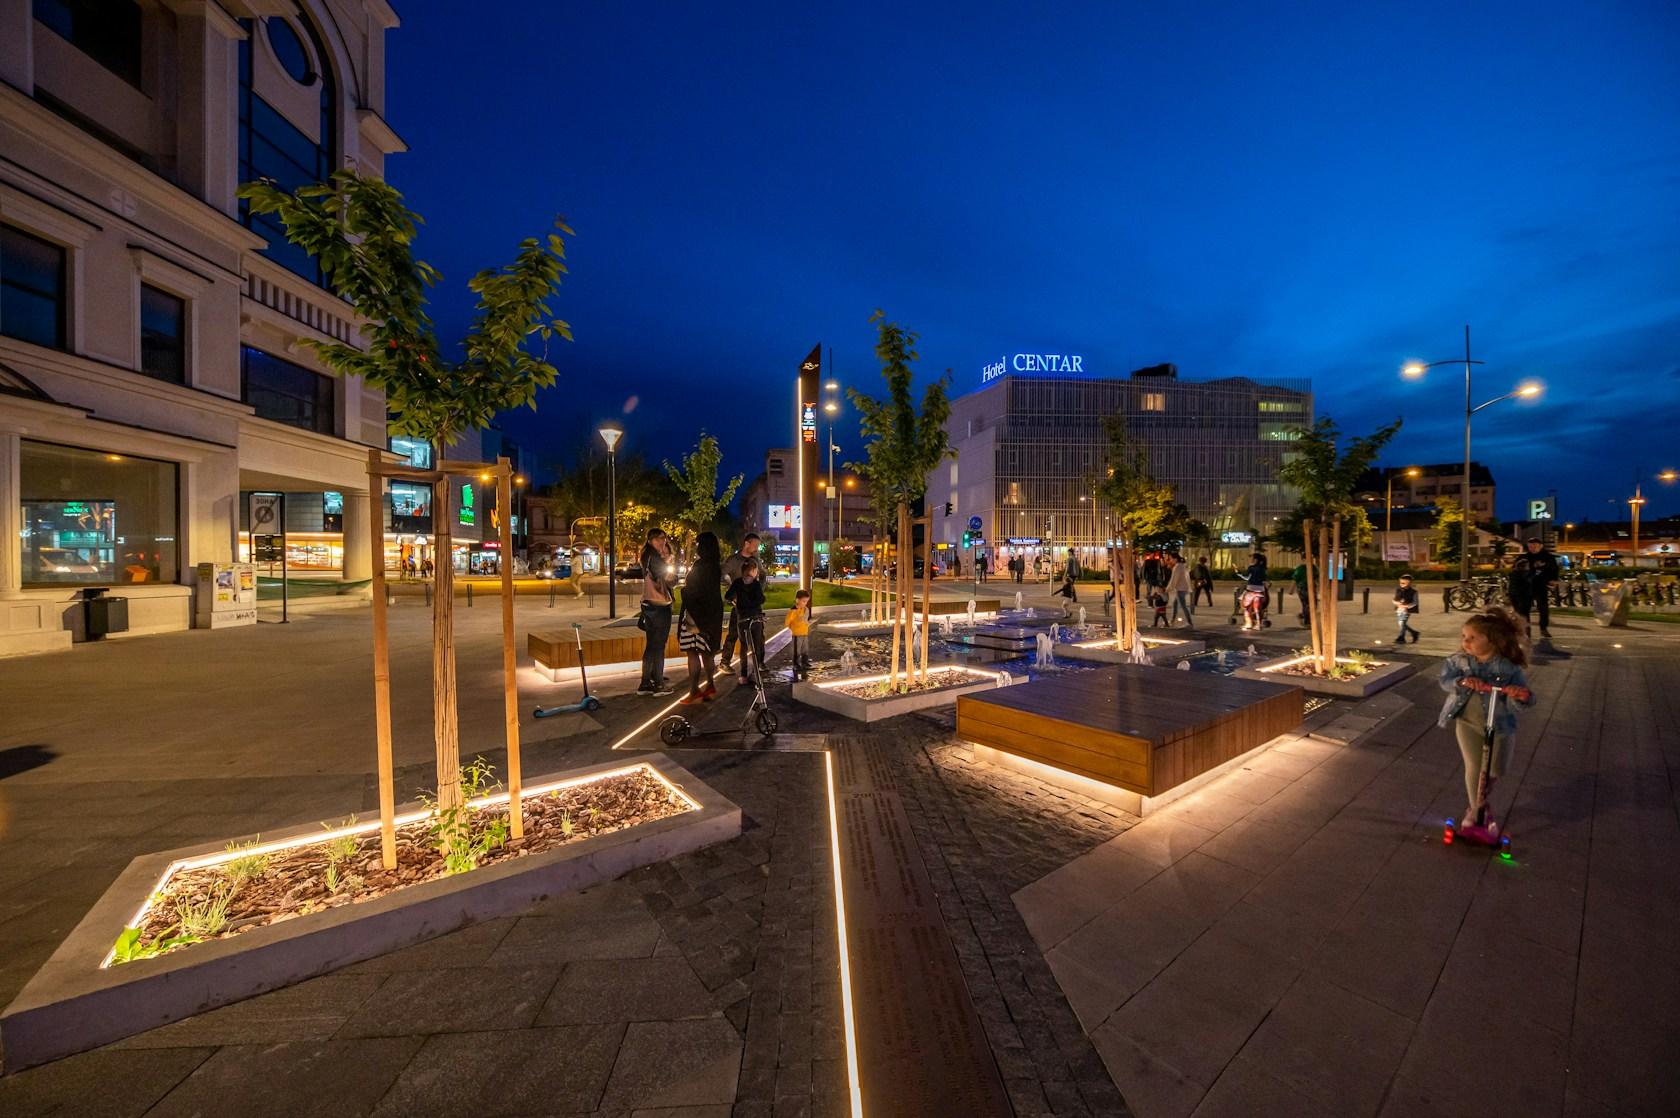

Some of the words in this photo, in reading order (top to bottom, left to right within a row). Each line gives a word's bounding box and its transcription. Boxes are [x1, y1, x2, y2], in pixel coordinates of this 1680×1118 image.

[982, 355, 1006, 383] Hotel
[1013, 353, 1083, 372] CENTAR
[1531, 498, 1546, 520] P
